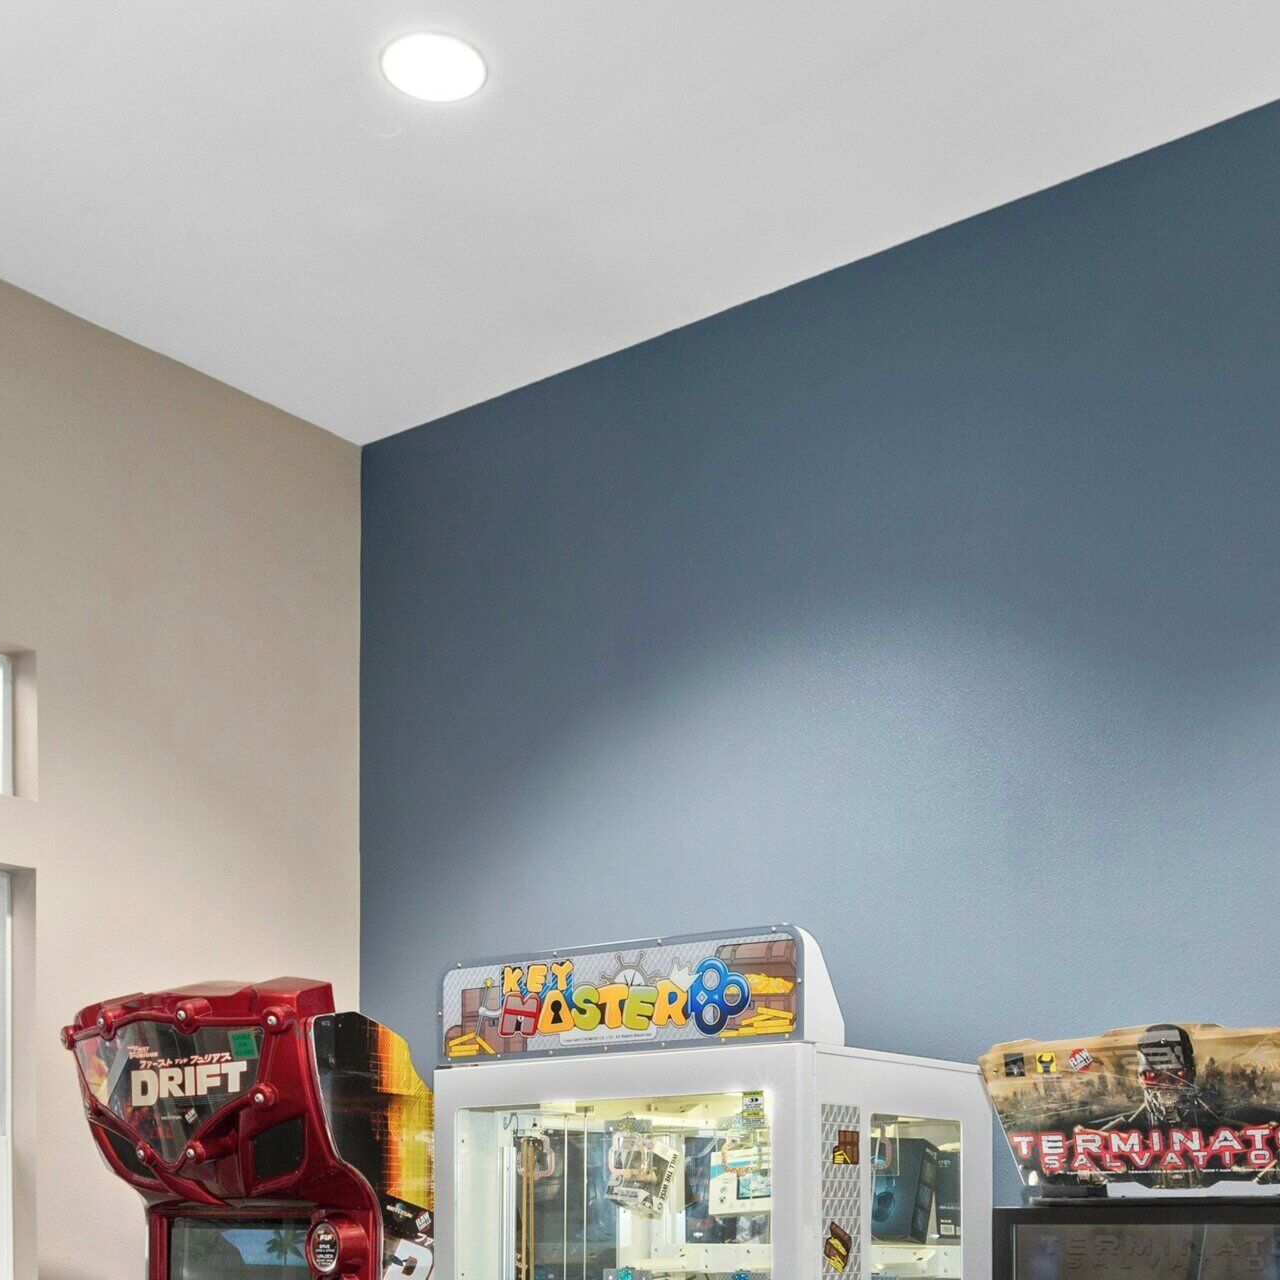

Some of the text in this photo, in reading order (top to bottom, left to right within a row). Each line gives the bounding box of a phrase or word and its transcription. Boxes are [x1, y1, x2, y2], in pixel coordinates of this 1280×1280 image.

[503, 960, 574, 994] KEY
[500, 978, 689, 1037] MASTER
[131, 1060, 248, 1107] DRIFT
[416, 1211, 431, 1228] RAW
